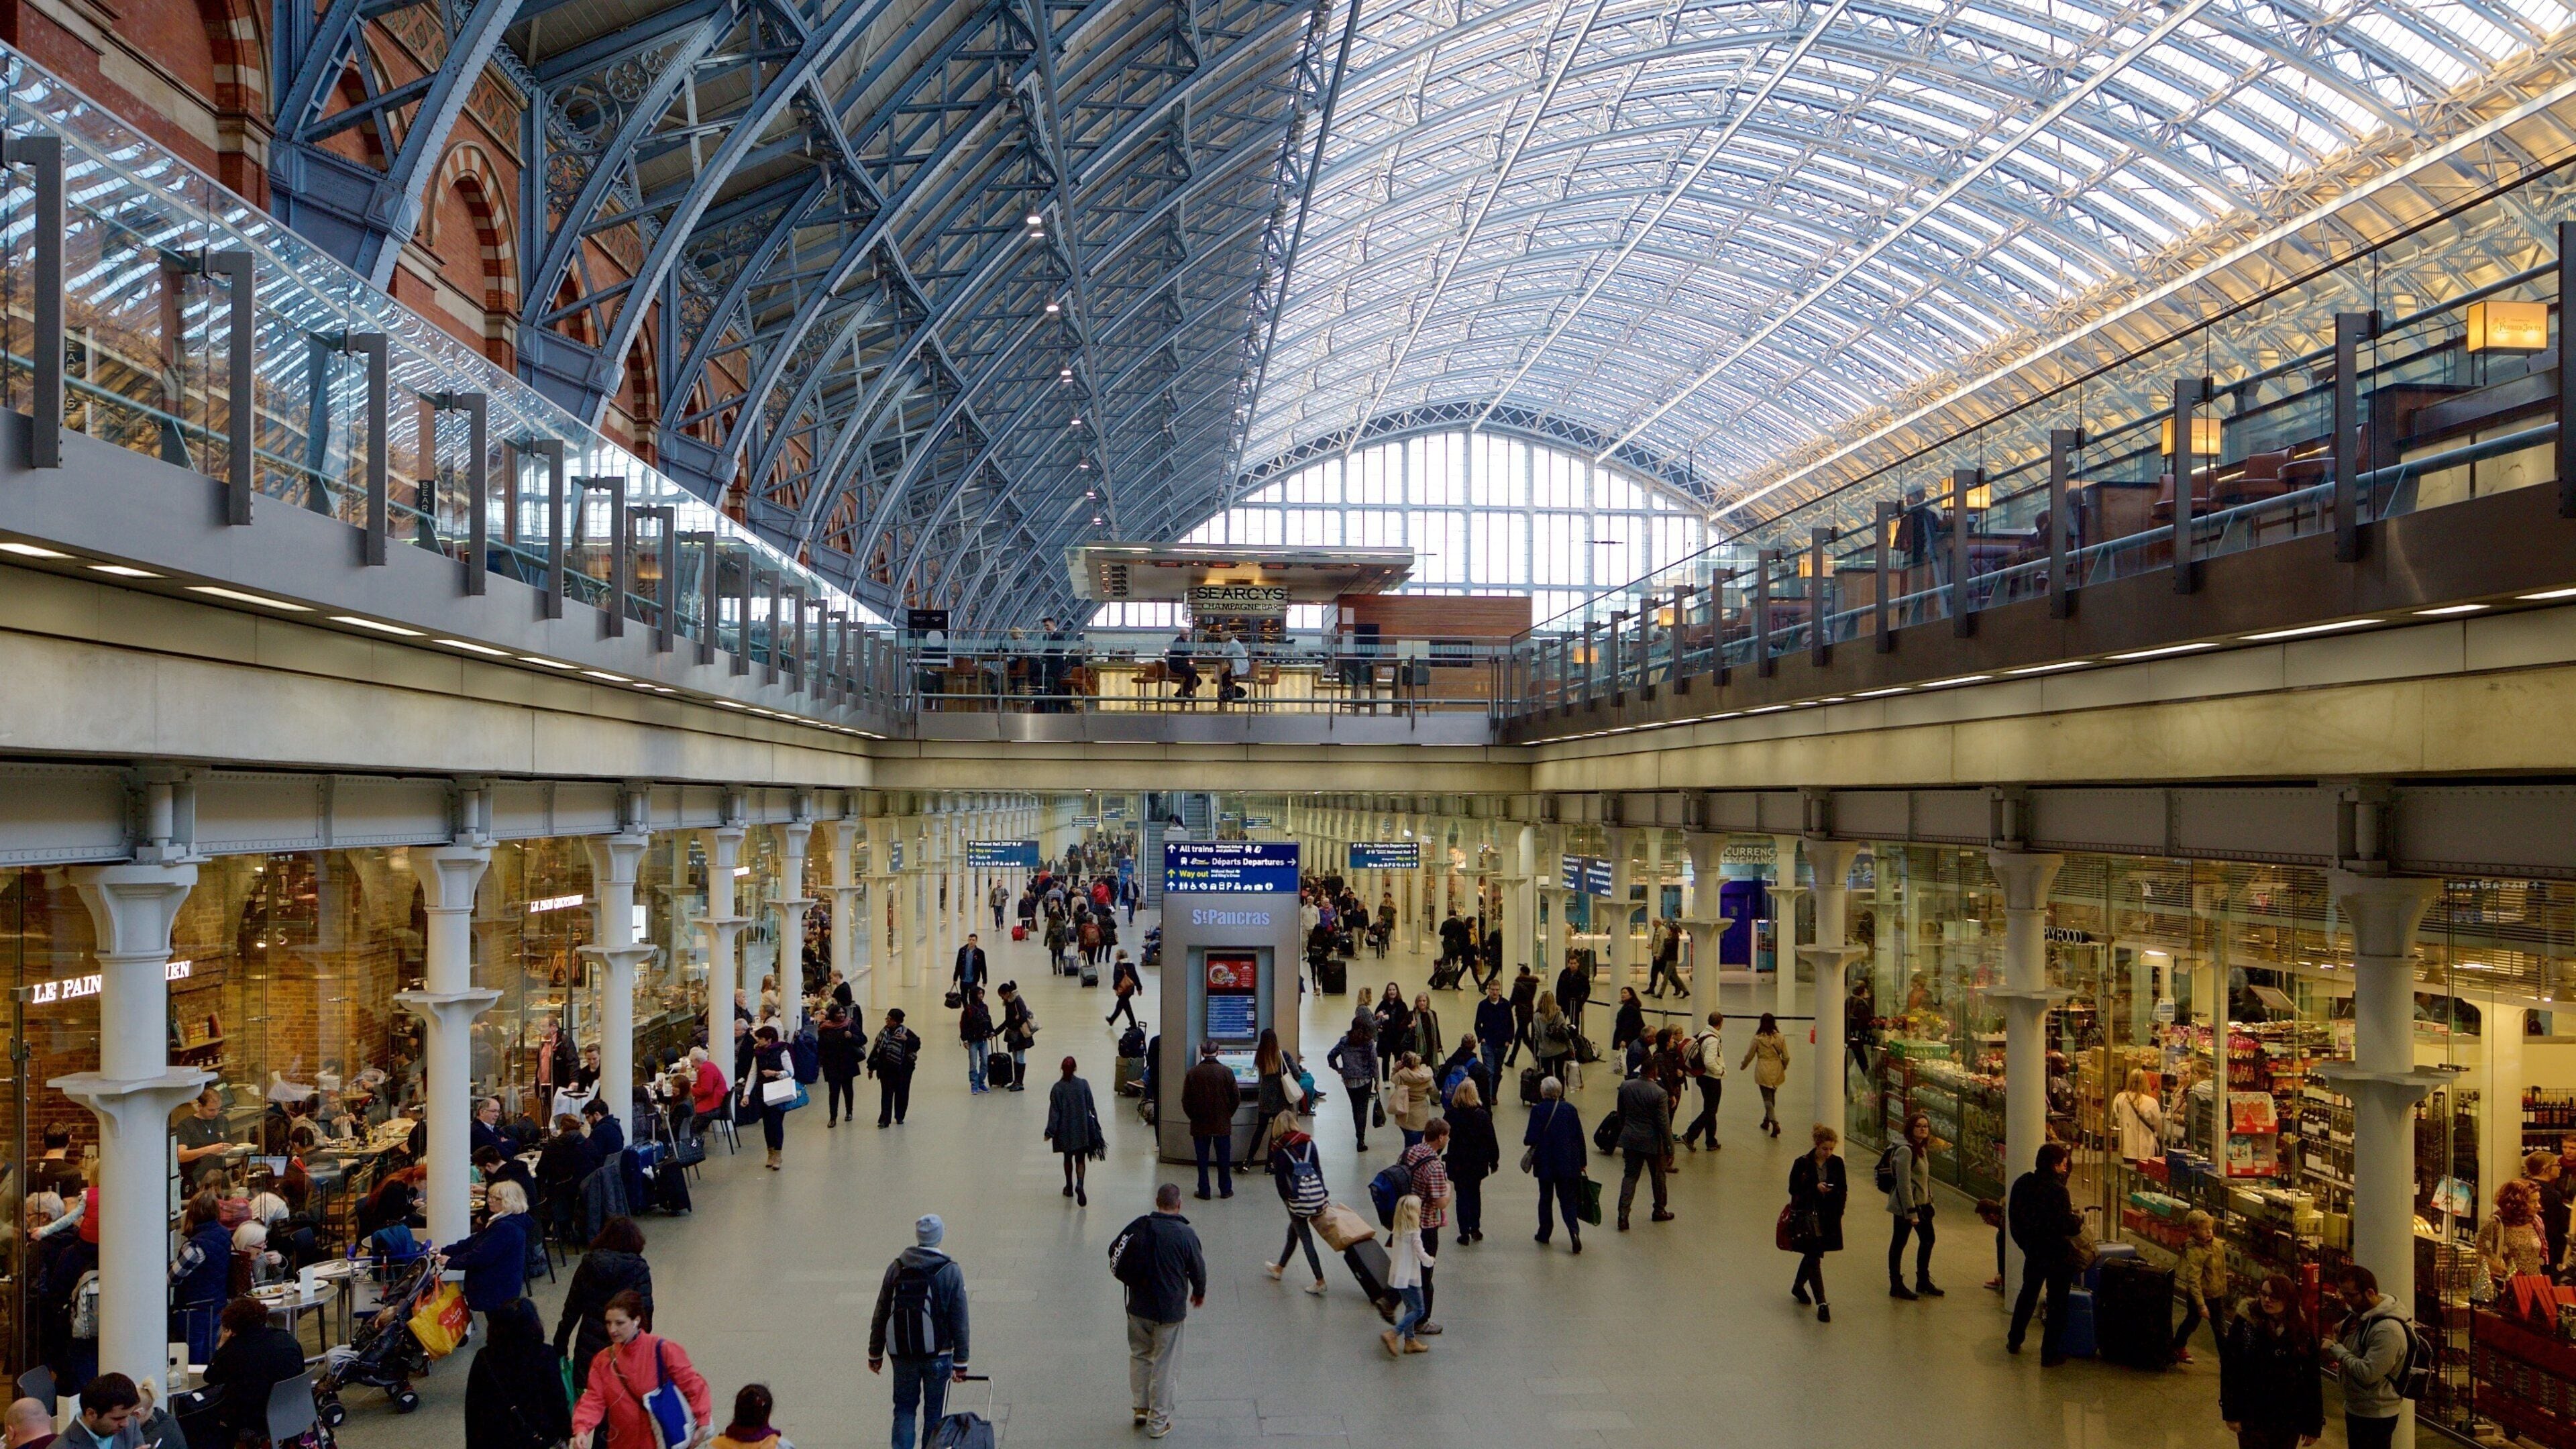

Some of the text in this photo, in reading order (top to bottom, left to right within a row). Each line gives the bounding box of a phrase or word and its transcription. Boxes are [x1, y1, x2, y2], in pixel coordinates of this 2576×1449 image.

[1196, 587, 1285, 600] SEARCYS
[1201, 602, 1260, 611] CHAMPAGNE
[1725, 847, 1776, 857] CURRENC
[1212, 857, 1241, 867] Départs
[1243, 858, 1285, 867] Departures
[1725, 856, 1776, 865] EXCHANG
[1179, 869, 1195, 879] Way
[2057, 927, 2082, 943] FOOD
[32, 974, 102, 1004] LE PAIN
[1110, 1234, 1129, 1275] adidas
